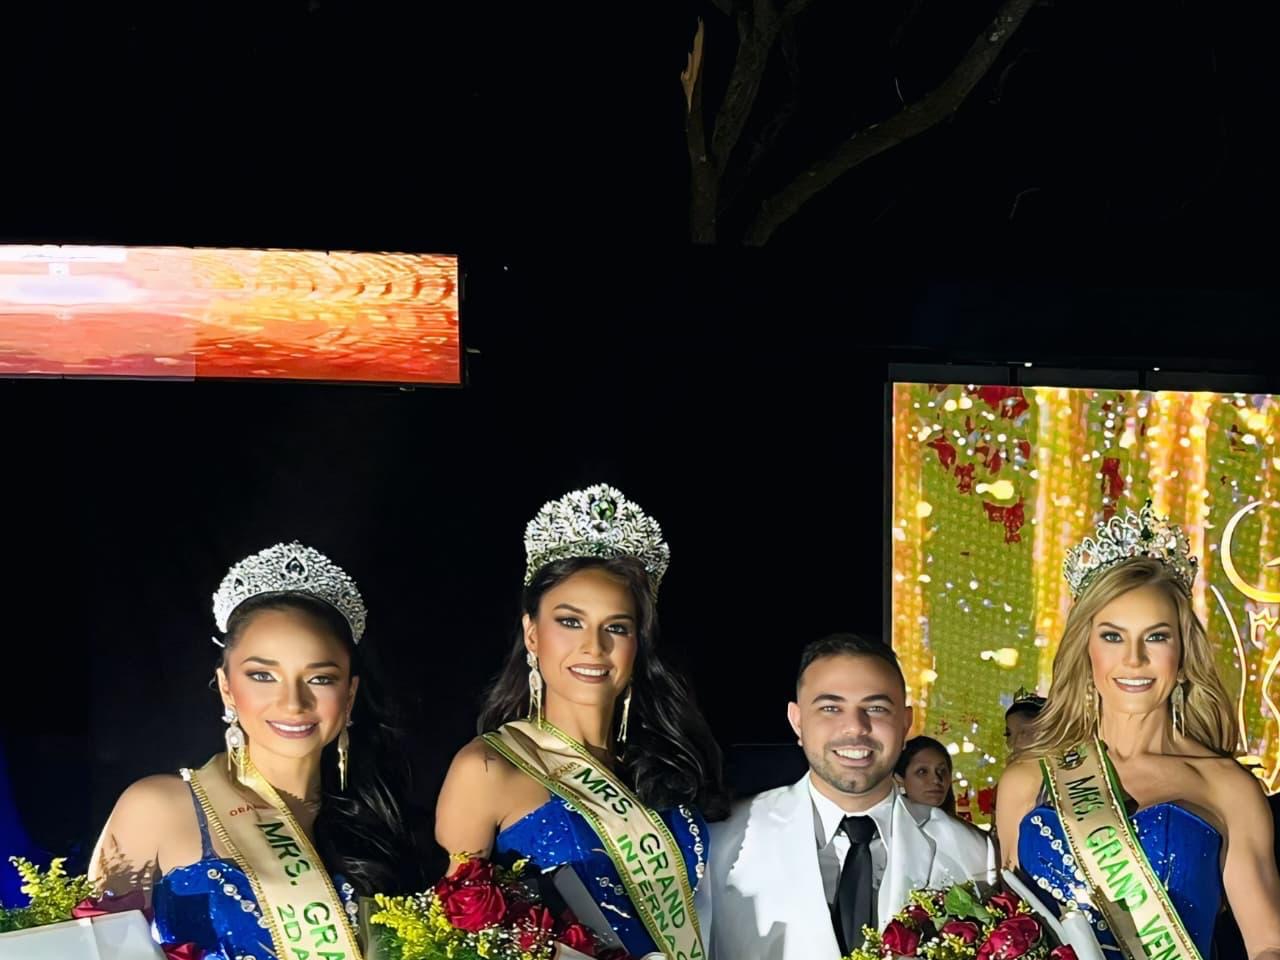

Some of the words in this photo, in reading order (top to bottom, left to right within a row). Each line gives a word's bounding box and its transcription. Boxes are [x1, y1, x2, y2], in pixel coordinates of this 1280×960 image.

[256, 822, 311, 885] MRS.
[573, 767, 634, 822] MRS.
[639, 833, 686, 928] GRAND
[1065, 775, 1104, 821] MRS.
[1085, 826, 1148, 912] GRAND
